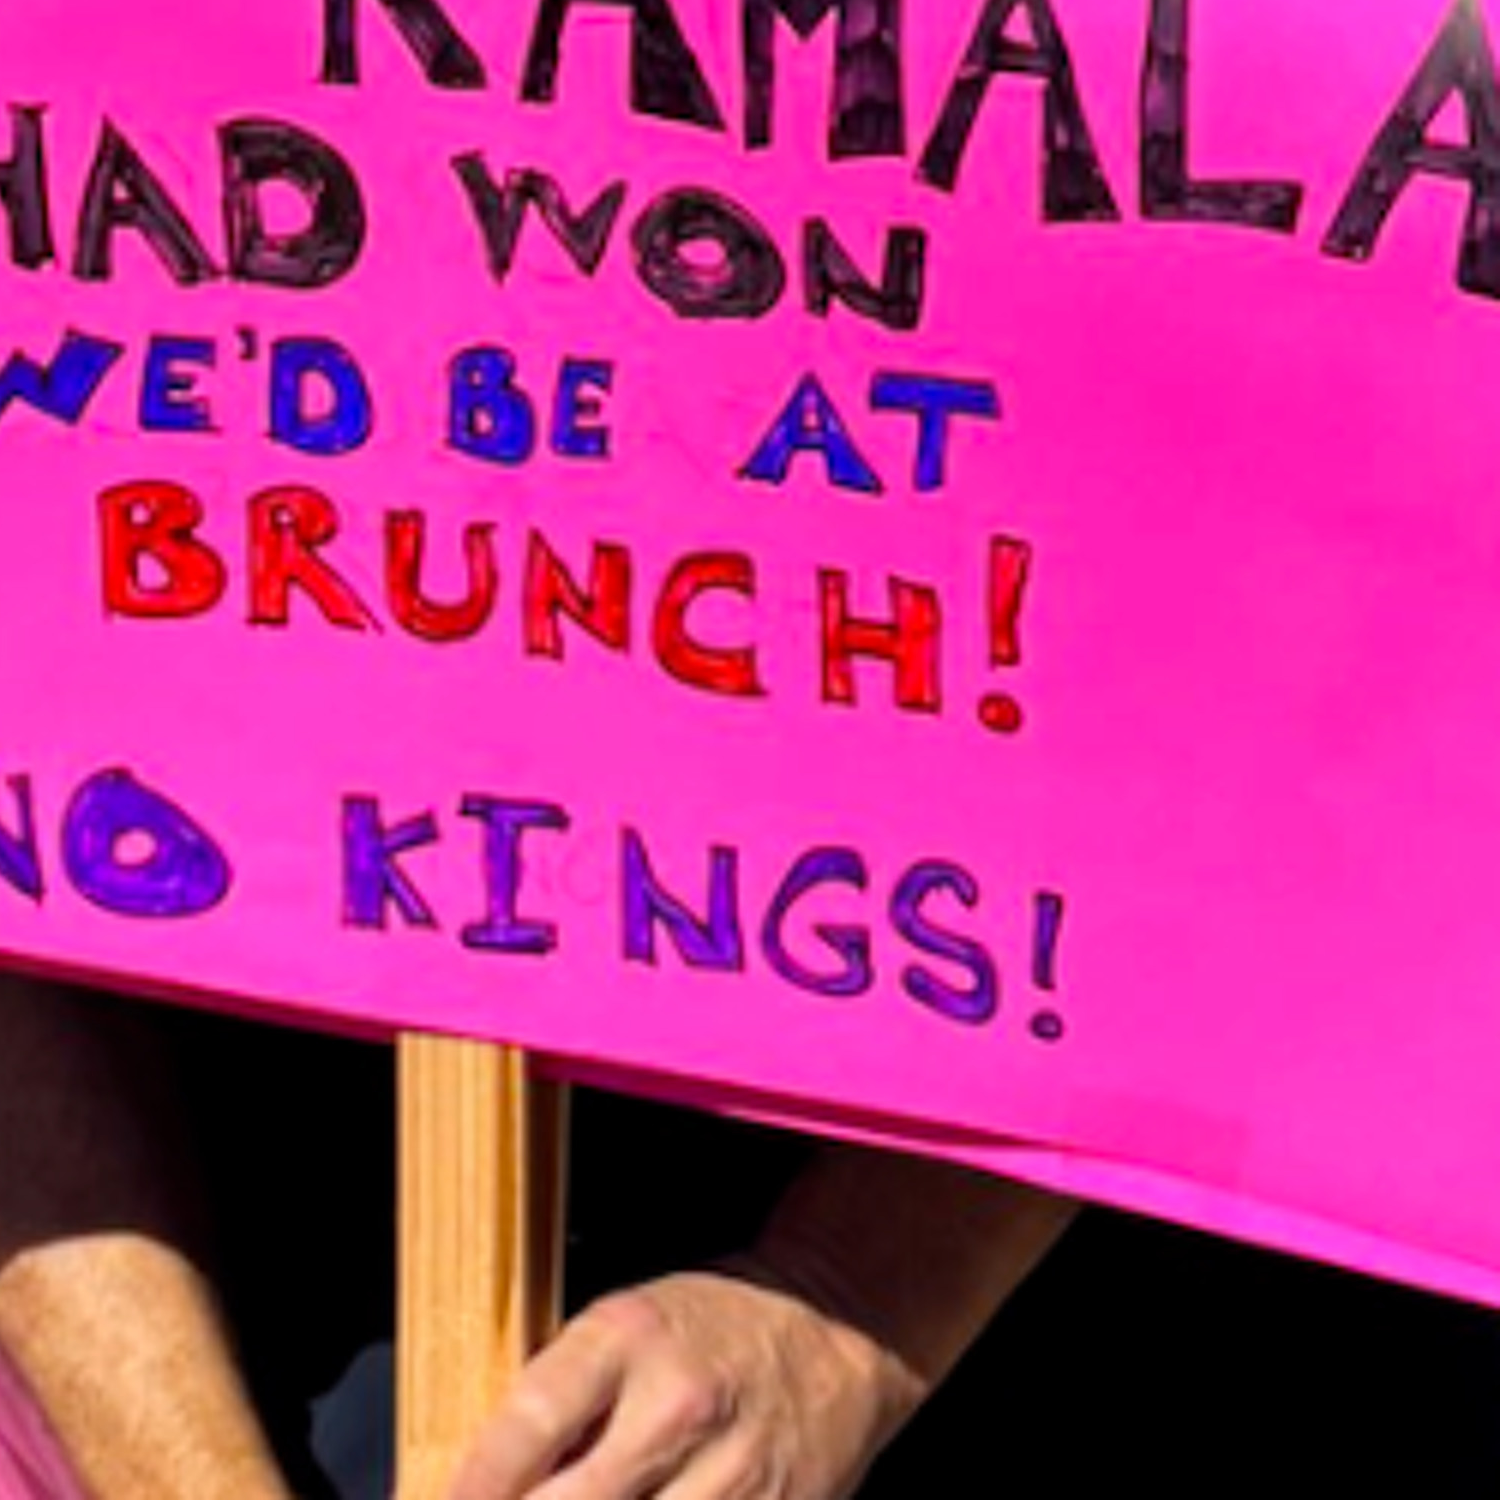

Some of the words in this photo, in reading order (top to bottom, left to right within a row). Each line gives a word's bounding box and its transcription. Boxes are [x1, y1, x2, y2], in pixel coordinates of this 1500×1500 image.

[450, 150, 928, 332] WON
[445, 345, 613, 468] BE
[735, 370, 1001, 496] AT
[97, 479, 1032, 734] BRUNCH!
[342, 794, 1064, 1041] KINGS!
